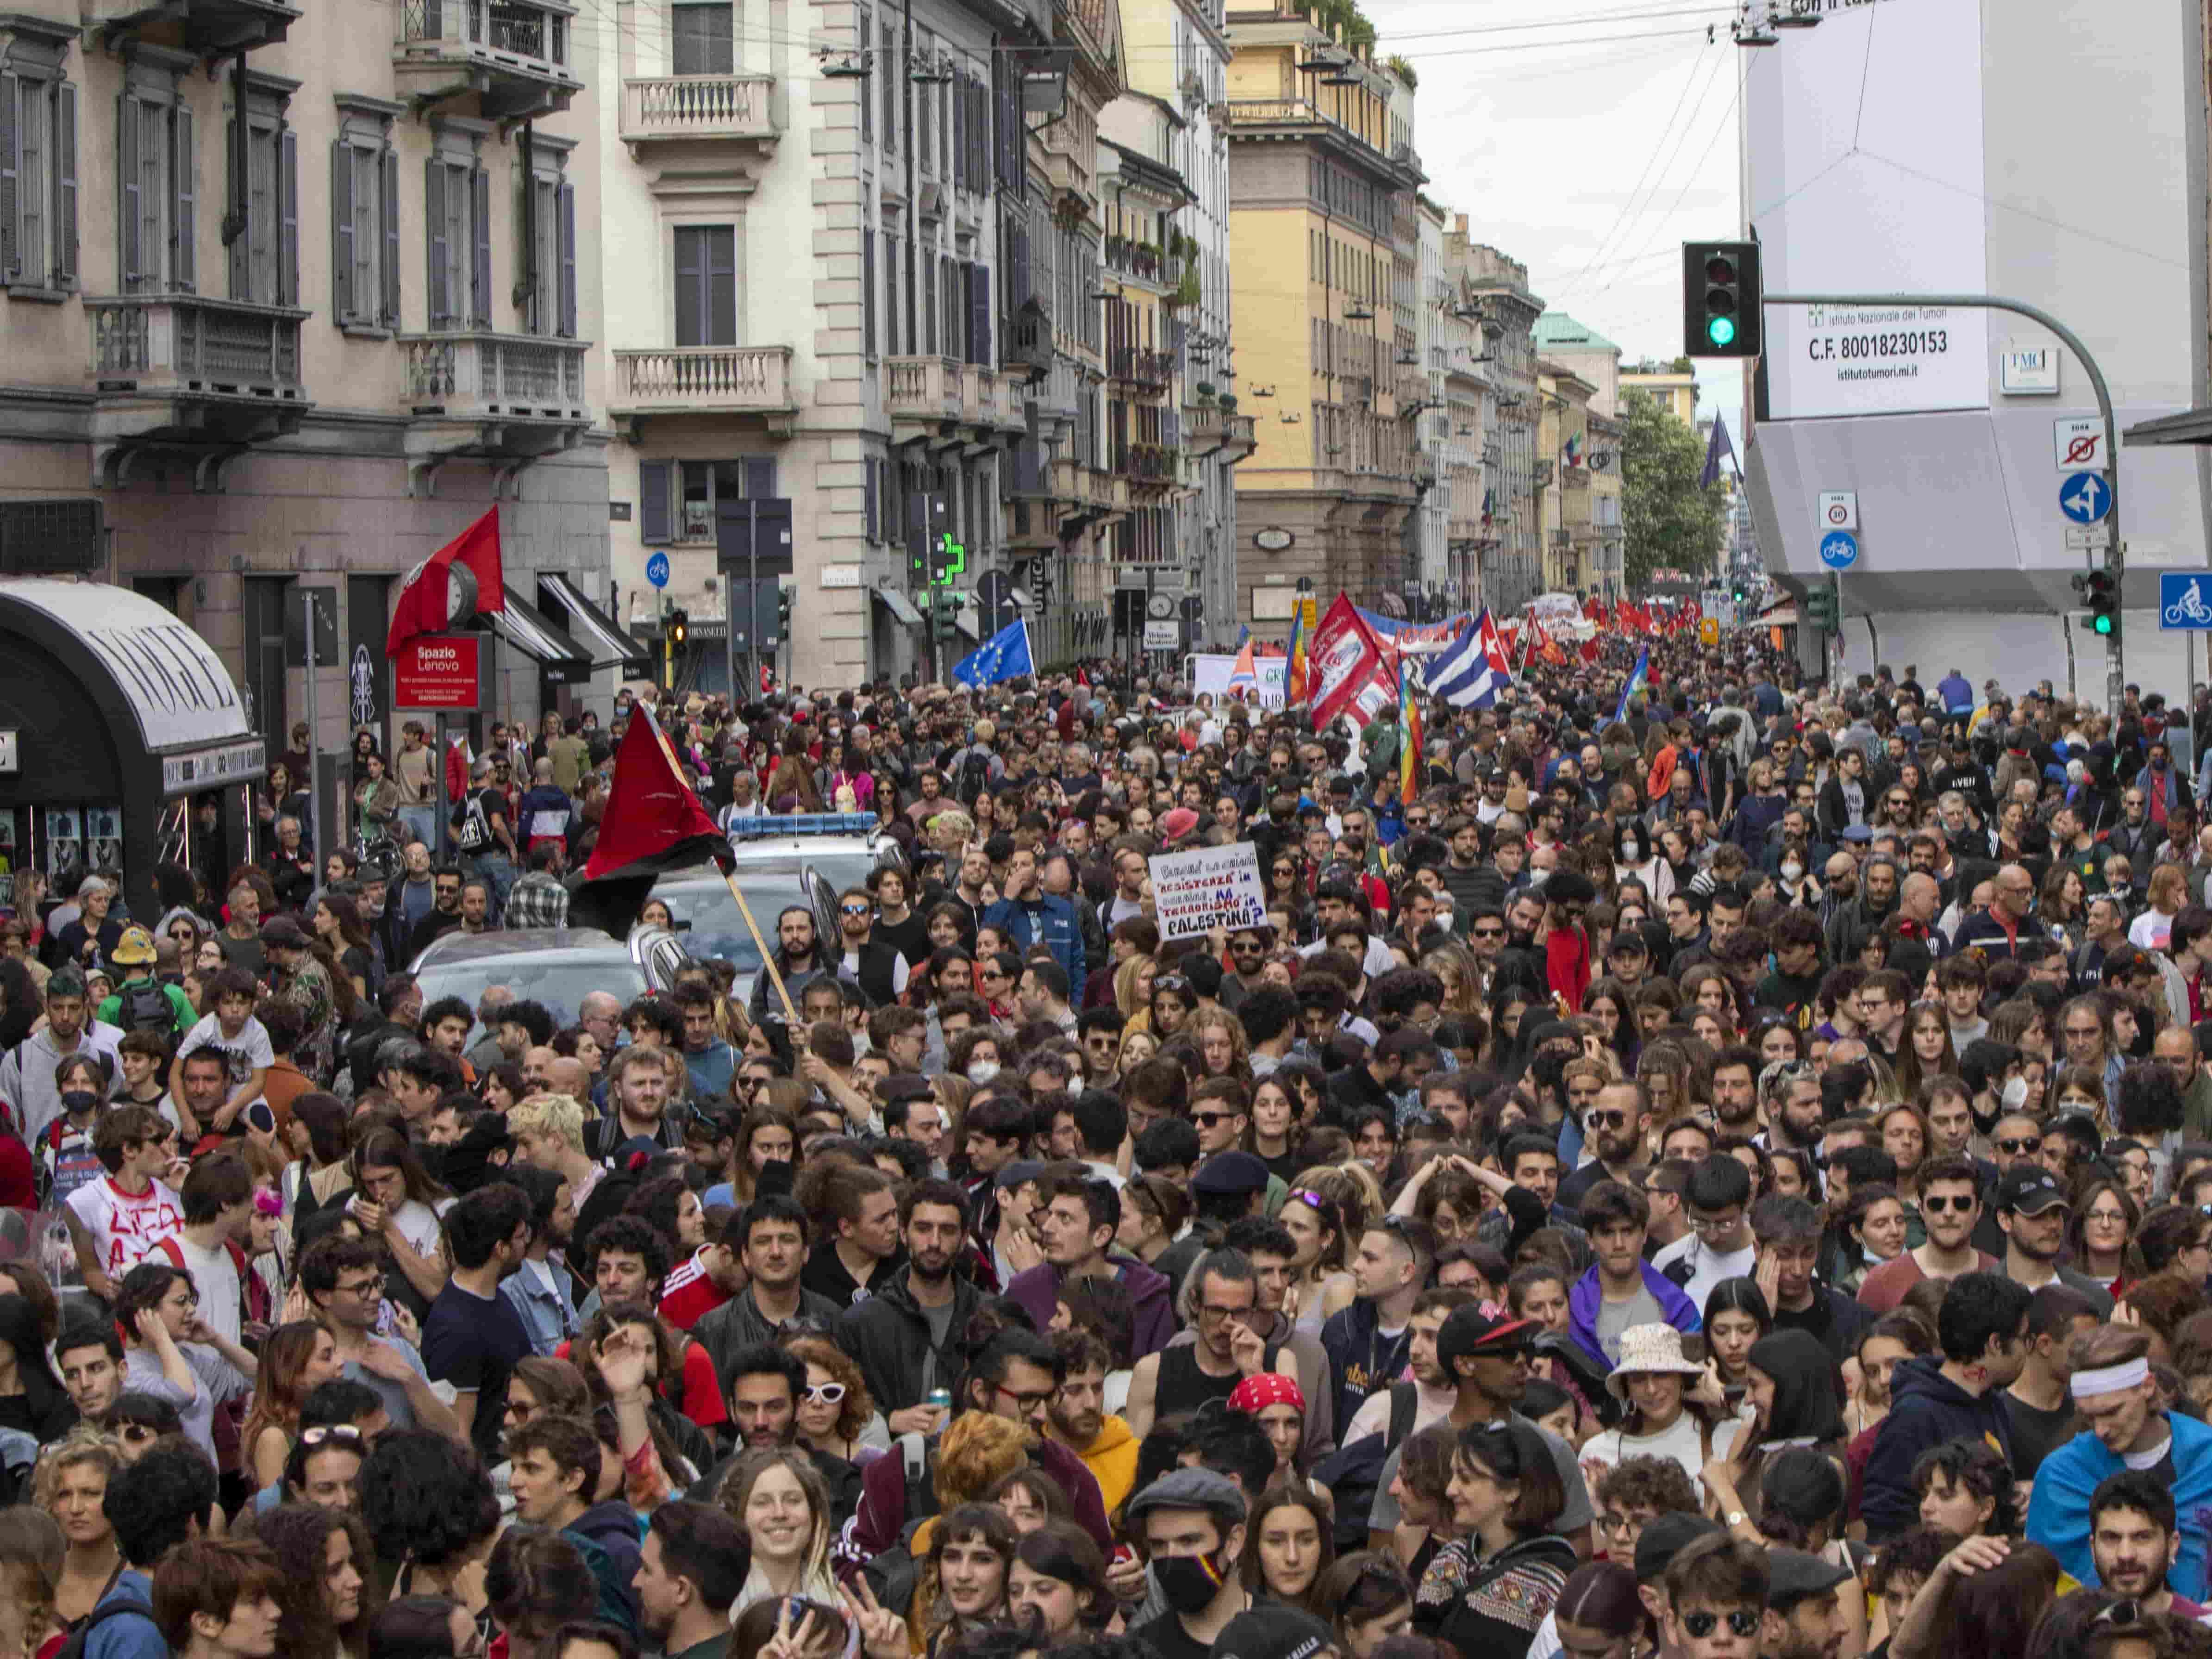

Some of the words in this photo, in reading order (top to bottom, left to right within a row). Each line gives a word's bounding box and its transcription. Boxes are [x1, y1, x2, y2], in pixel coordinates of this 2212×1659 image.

[1829, 313, 1856, 327] Istituto
[1858, 310, 1899, 324] Nazionale
[1903, 308, 1915, 320] dei
[1919, 305, 1948, 320] Tumori
[1809, 337, 1836, 360] C.F.
[1841, 330, 1948, 359] 80018230153
[1837, 363, 1918, 381] istitutotumori.mi.it
[418, 646, 456, 660] Spazio
[87, 625, 235, 716] VOGUE
[418, 659, 459, 672] Lenovo
